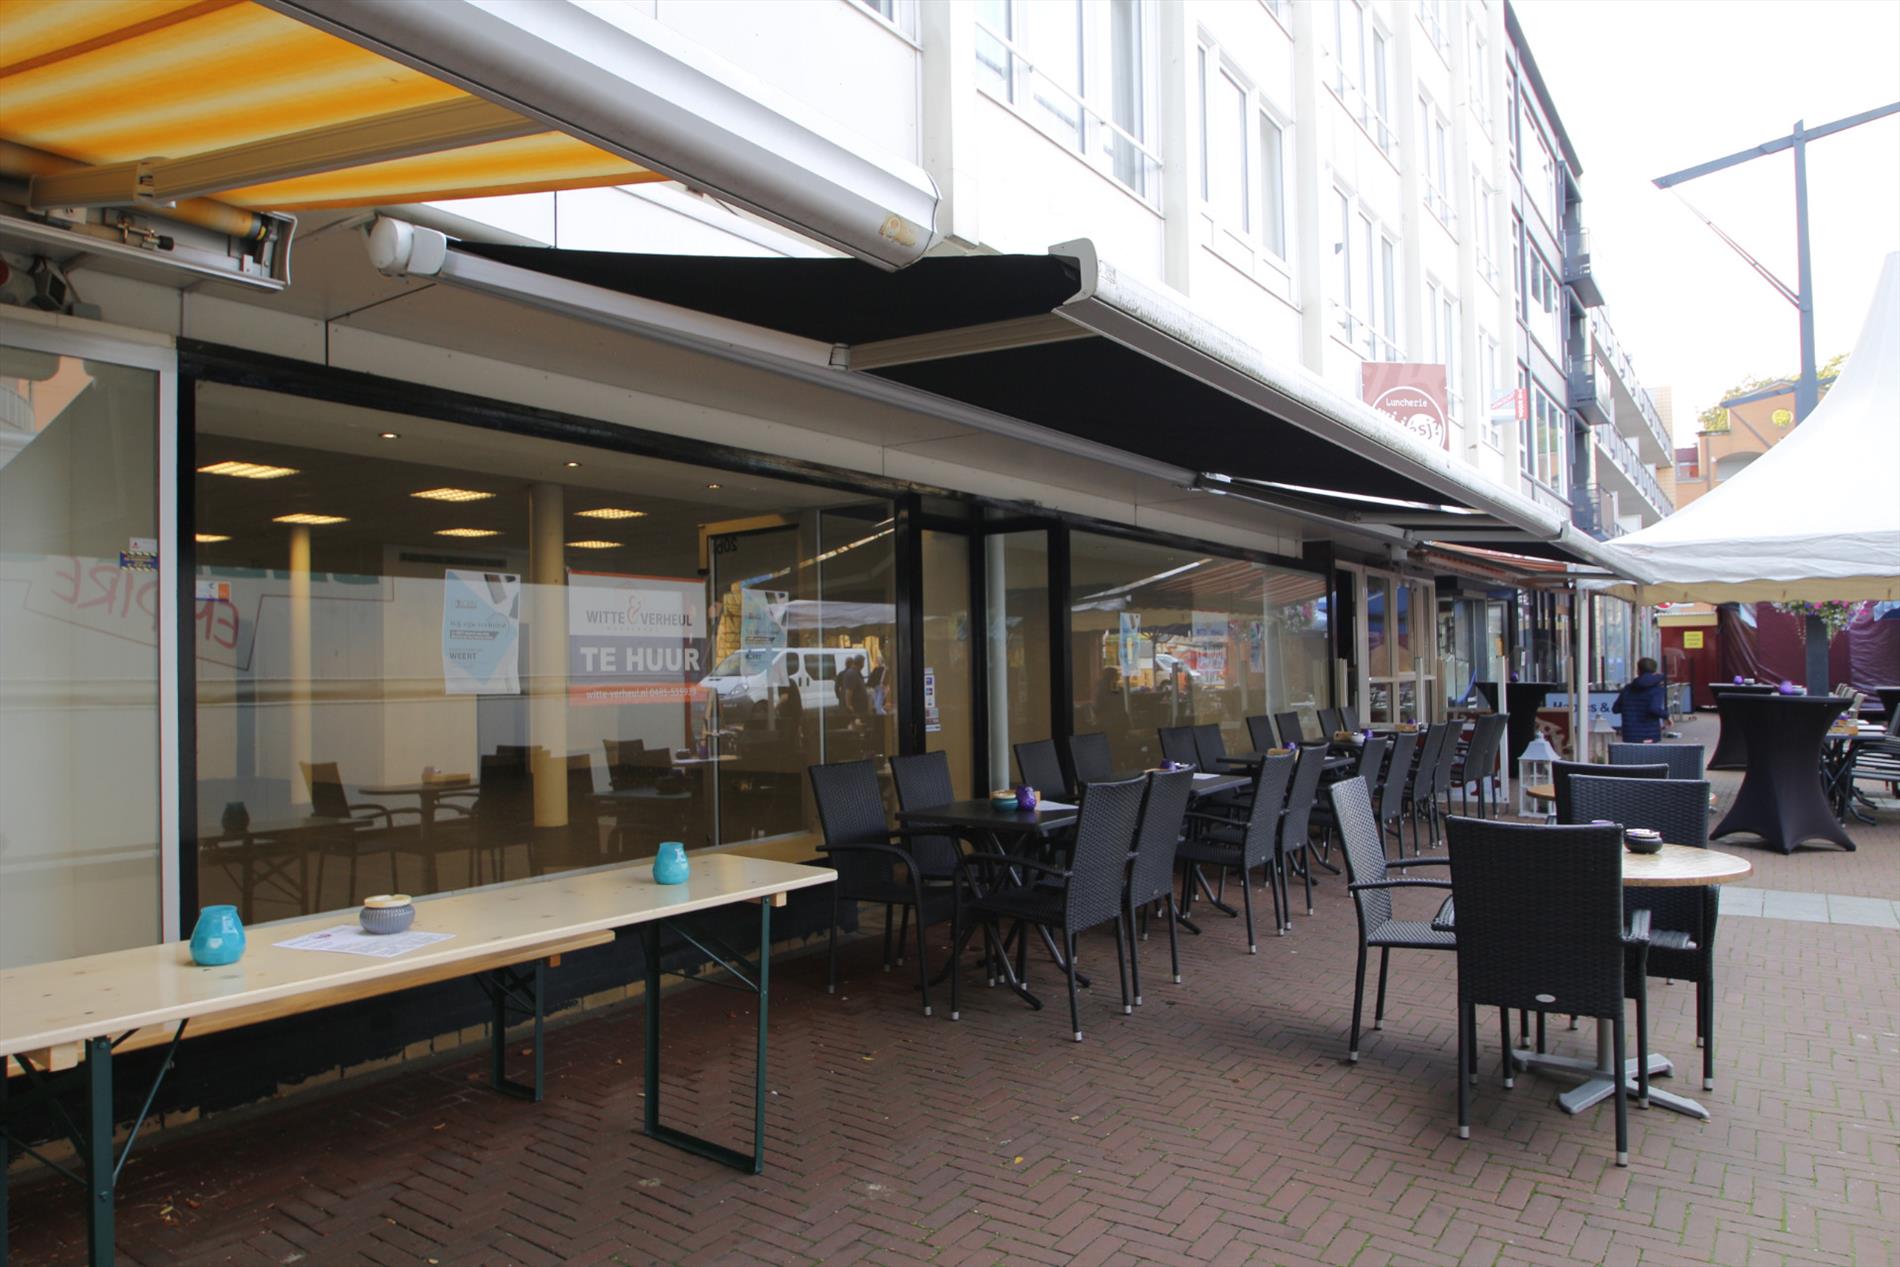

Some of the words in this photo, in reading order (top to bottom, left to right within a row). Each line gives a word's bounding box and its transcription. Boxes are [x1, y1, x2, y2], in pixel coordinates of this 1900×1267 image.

[1386, 397, 1428, 408] Luncherie
[586, 610, 625, 624] WITTE
[627, 594, 641, 624] &
[640, 612, 693, 626] VERHEUL
[580, 646, 617, 672] TE
[626, 647, 700, 672] HUUR
[1600, 702, 1610, 713] &
